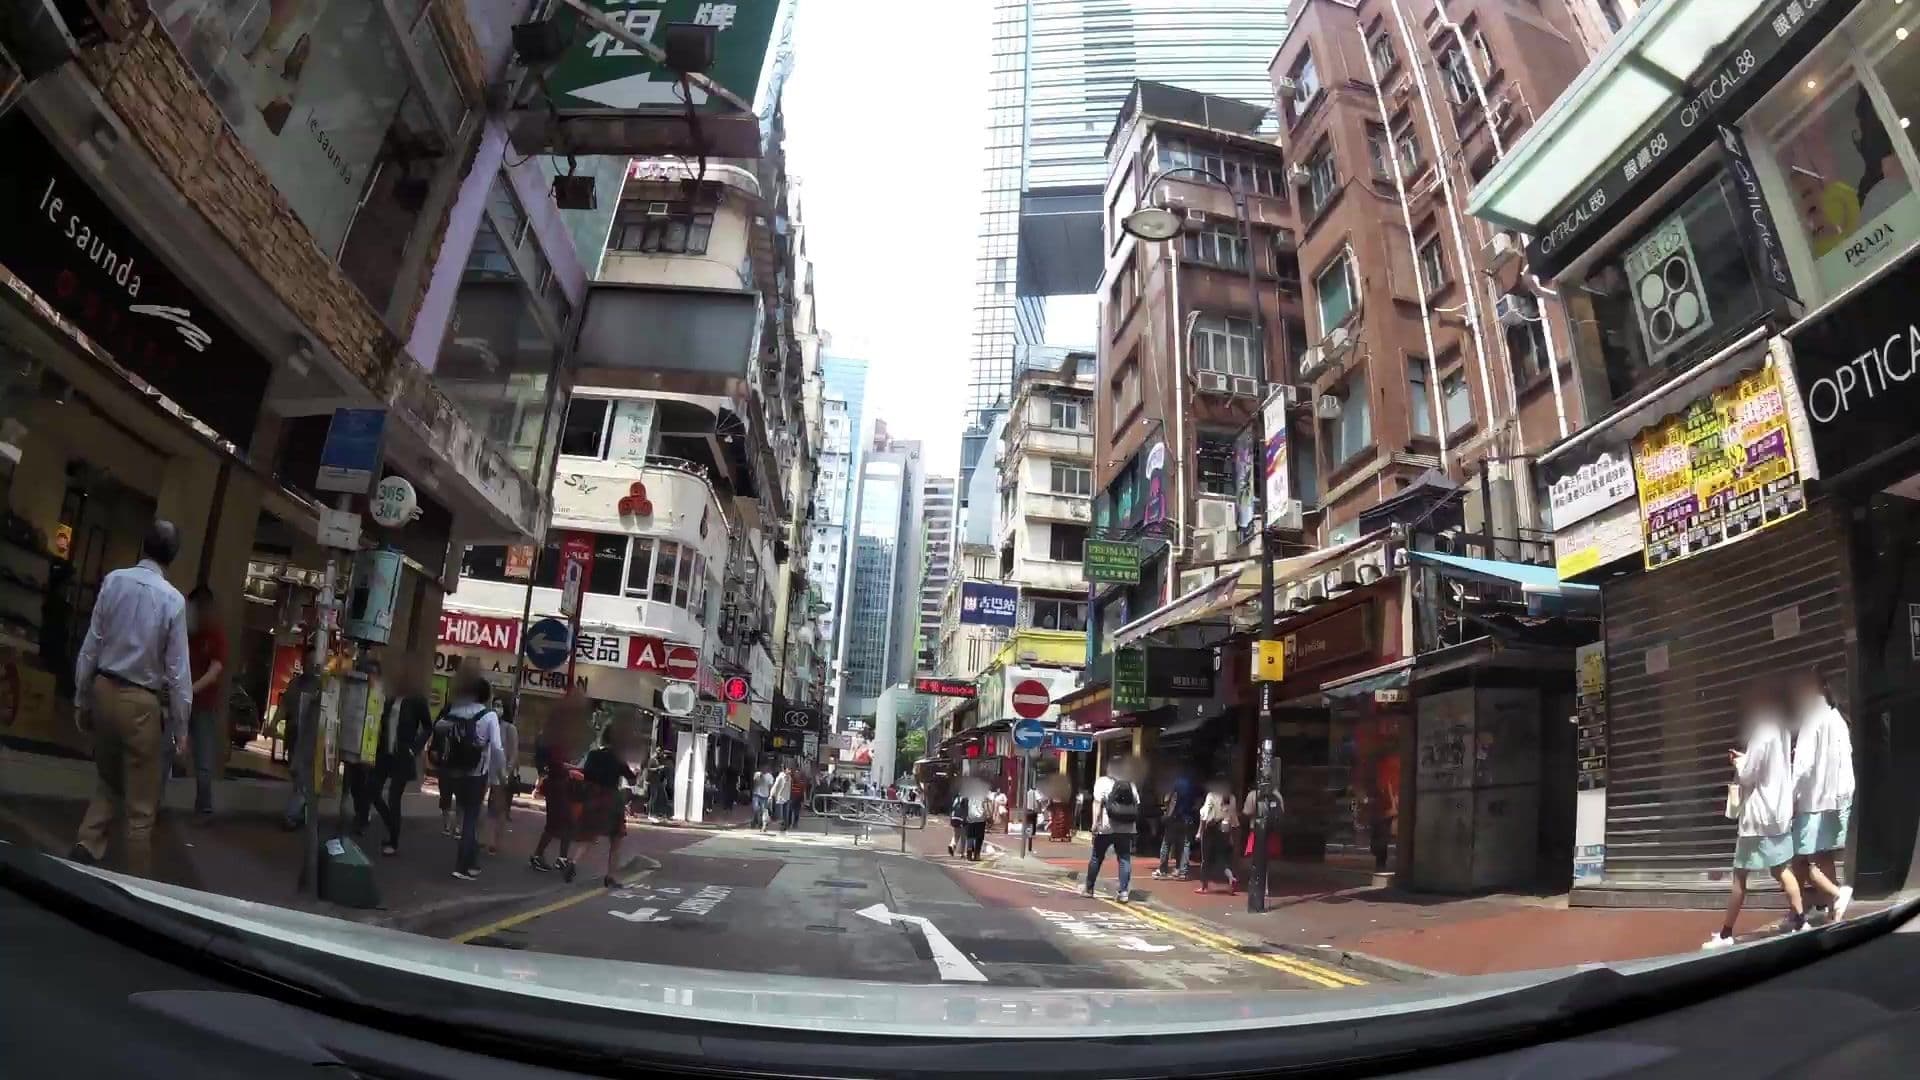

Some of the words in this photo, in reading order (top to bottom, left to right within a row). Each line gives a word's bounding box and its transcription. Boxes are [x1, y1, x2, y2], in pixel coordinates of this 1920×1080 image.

[586, 9, 662, 58] 租
[1772, 0, 1817, 38] 眼鏡
[1680, 68, 1740, 127] OPTICAL
[1736, 49, 1755, 74] 88
[40, 177, 63, 223] le
[64, 214, 141, 298] saunda
[1540, 203, 1592, 254] OPTICAL
[1588, 187, 1606, 212] 88
[1844, 222, 1895, 264] PRADA
[575, 633, 620, 663] 良品
